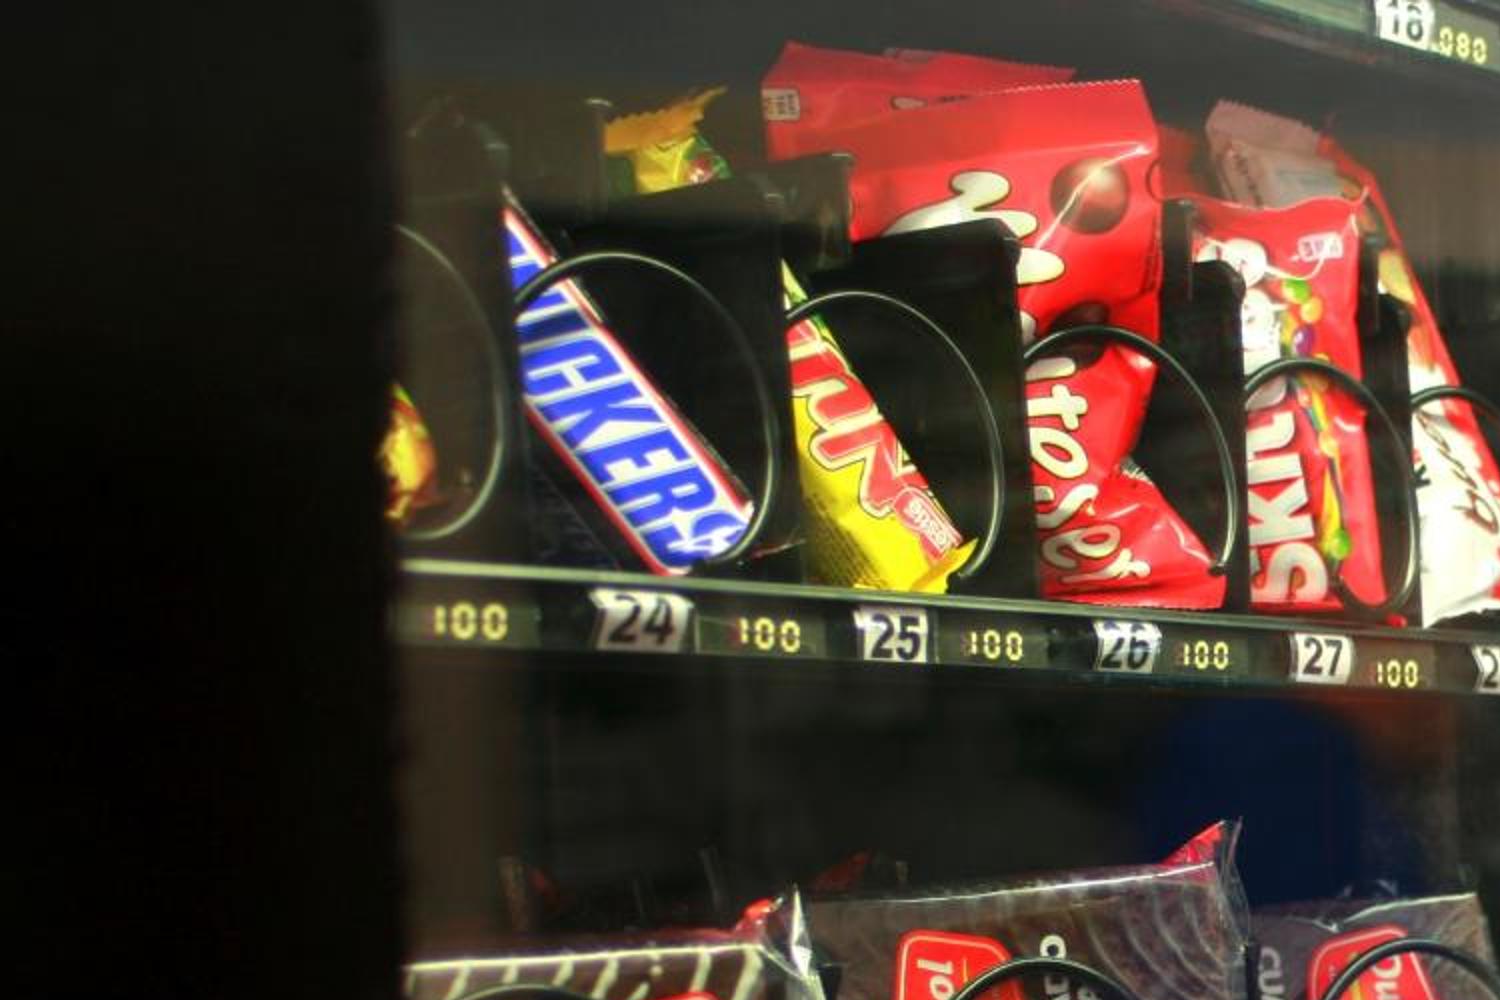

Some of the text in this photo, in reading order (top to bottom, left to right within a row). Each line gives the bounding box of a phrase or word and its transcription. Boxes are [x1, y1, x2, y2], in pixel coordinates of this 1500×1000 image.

[1439, 26, 1488, 65] 080
[433, 602, 509, 641] 100
[607, 593, 801, 654] 24 100
[870, 612, 1024, 662] 25 100
[1101, 619, 1230, 670] 26 100
[1302, 636, 1420, 689] 27 100
